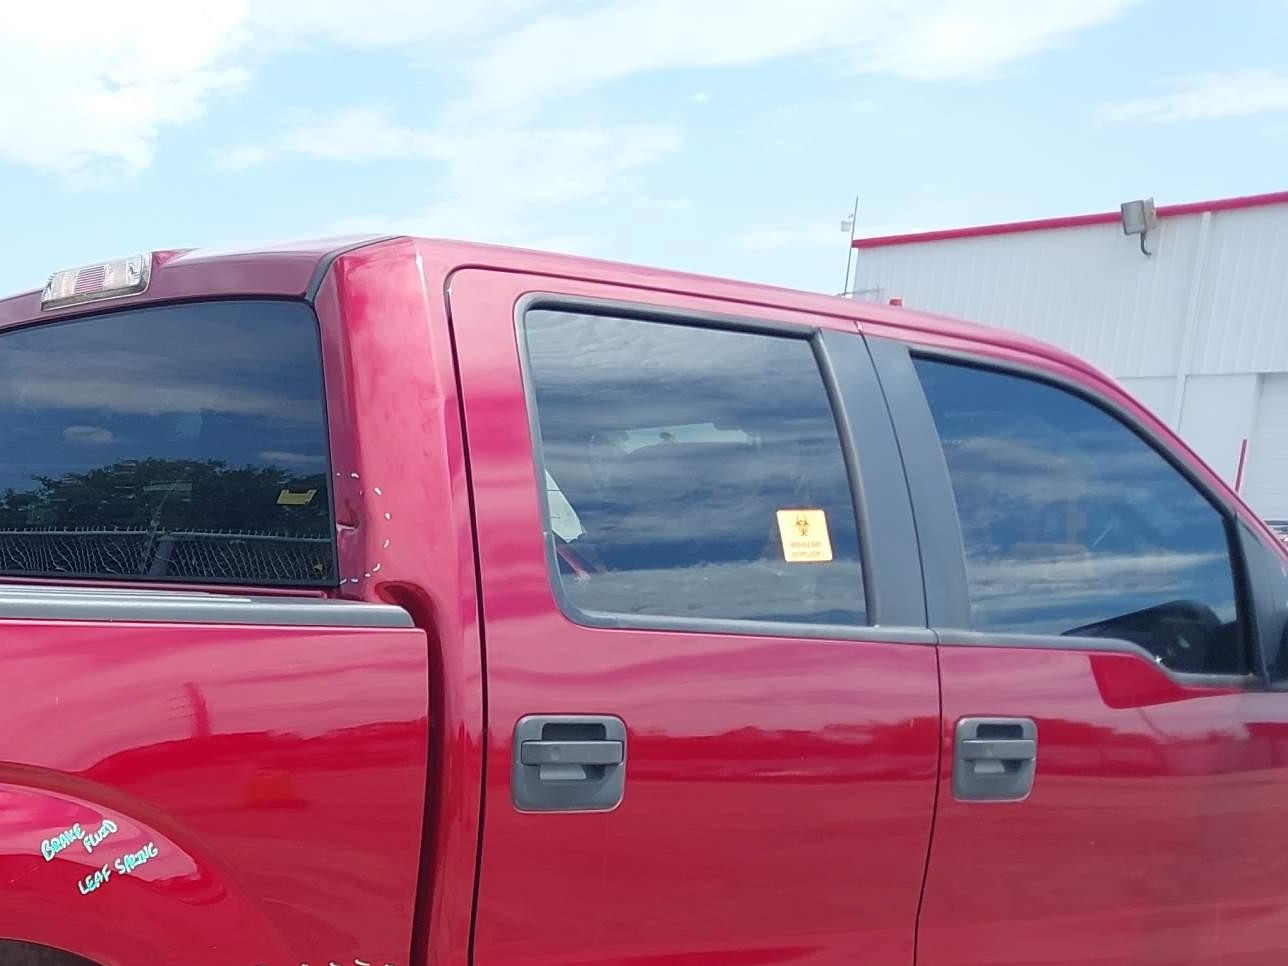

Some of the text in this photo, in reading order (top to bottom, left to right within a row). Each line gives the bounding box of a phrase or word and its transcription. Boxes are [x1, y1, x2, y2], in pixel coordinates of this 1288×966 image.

[41, 823, 85, 861] BRAKE
[83, 820, 117, 853] FLUID
[78, 842, 158, 895] LEAF SPRING
